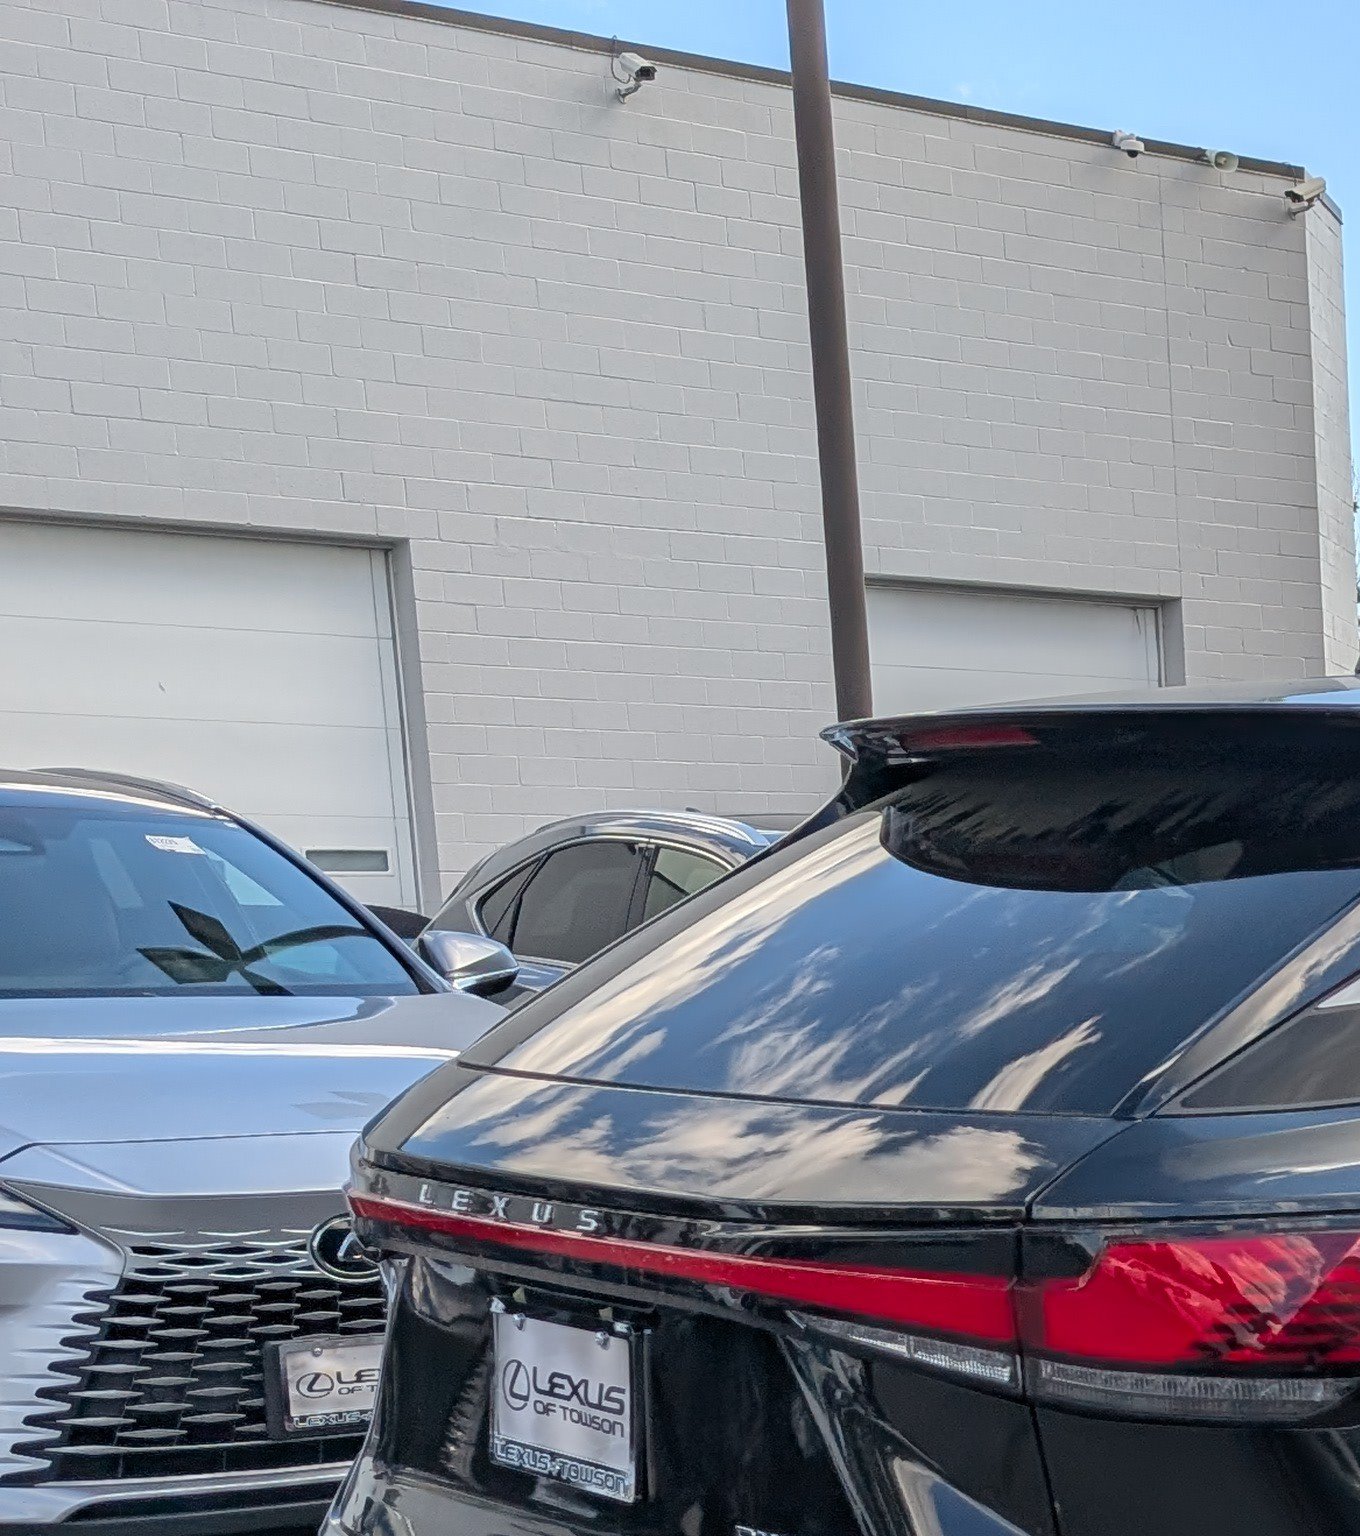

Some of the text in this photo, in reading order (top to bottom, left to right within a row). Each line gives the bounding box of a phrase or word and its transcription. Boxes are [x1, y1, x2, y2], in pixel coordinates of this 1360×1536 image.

[419, 1184, 600, 1231] LEXUS
[338, 1385, 362, 1395] OF
[532, 1366, 626, 1416] LEXUS
[294, 1411, 360, 1428] LEXUS
[533, 1400, 625, 1438] OF TOWSON
[494, 1439, 550, 1473] LEXUS
